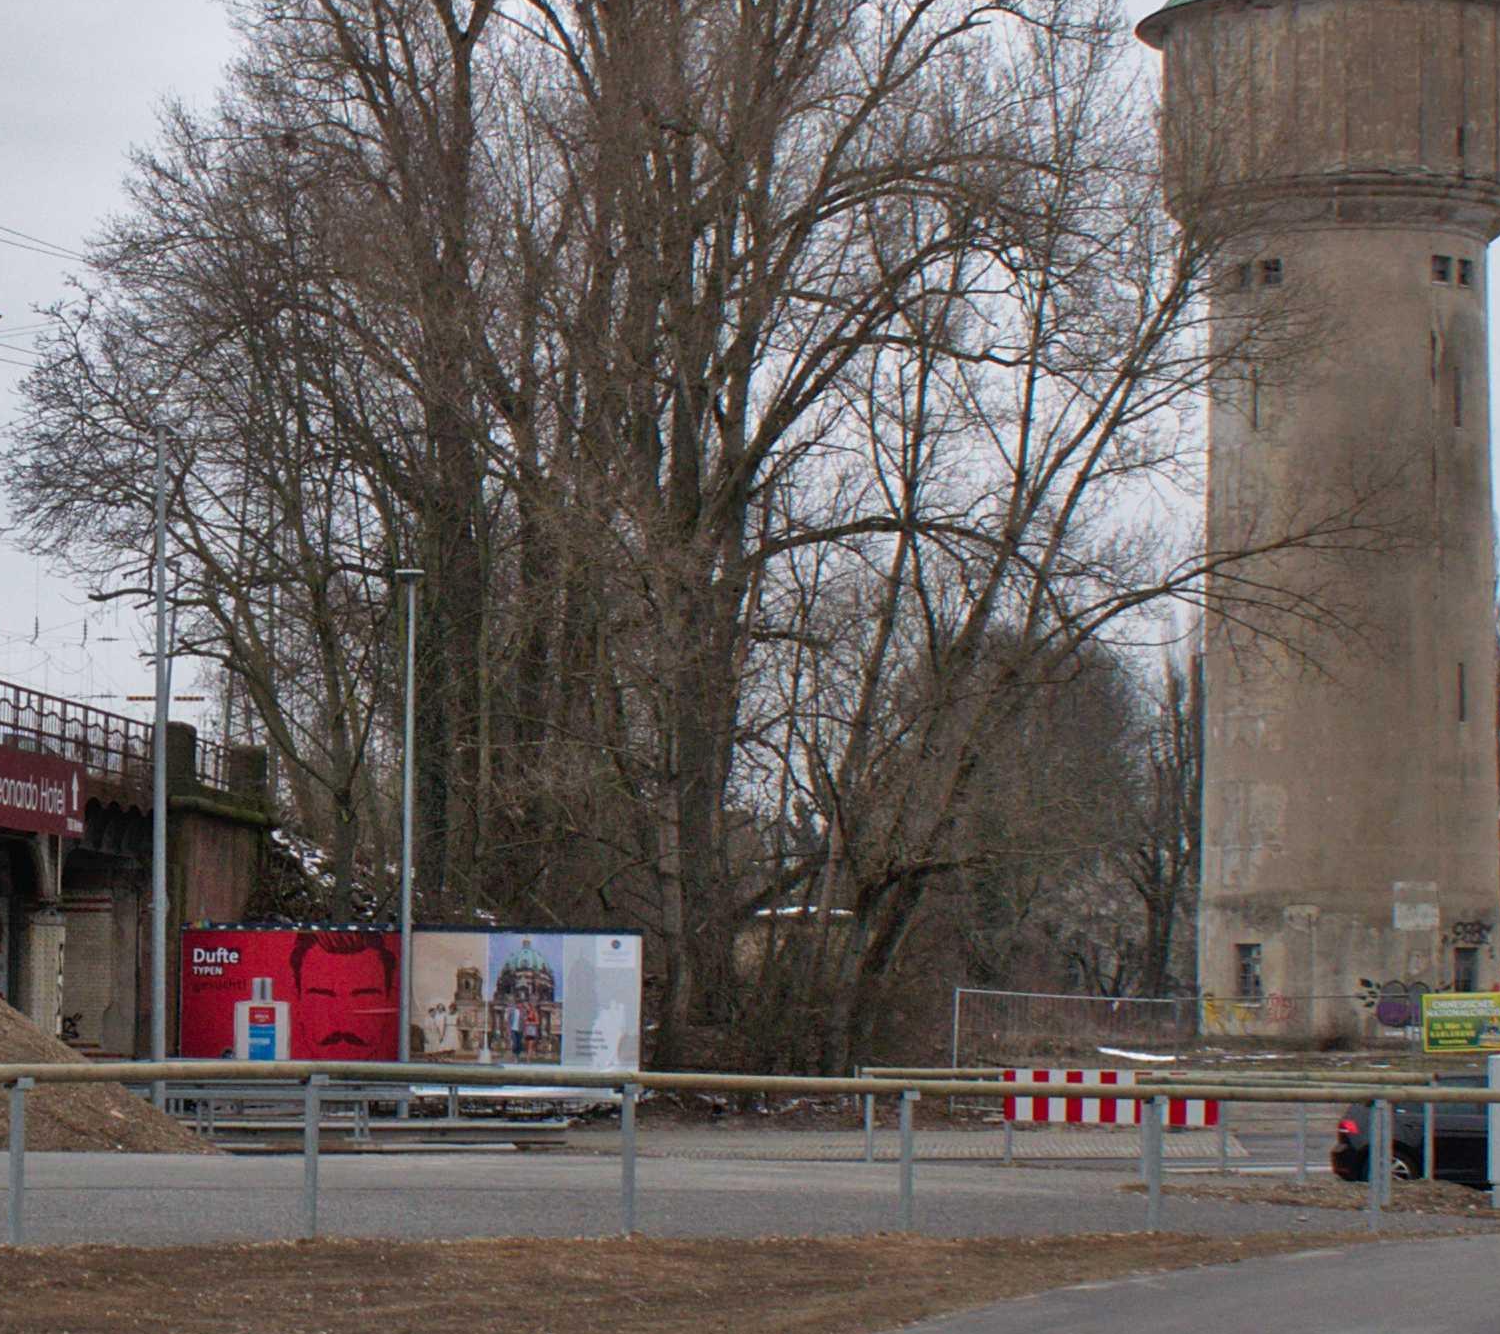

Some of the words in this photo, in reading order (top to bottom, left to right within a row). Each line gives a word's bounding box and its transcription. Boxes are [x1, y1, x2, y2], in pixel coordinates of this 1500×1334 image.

[40, 776, 66, 816] Hotel
[193, 947, 239, 963] Dufte
[193, 966, 223, 975] TYPEN
